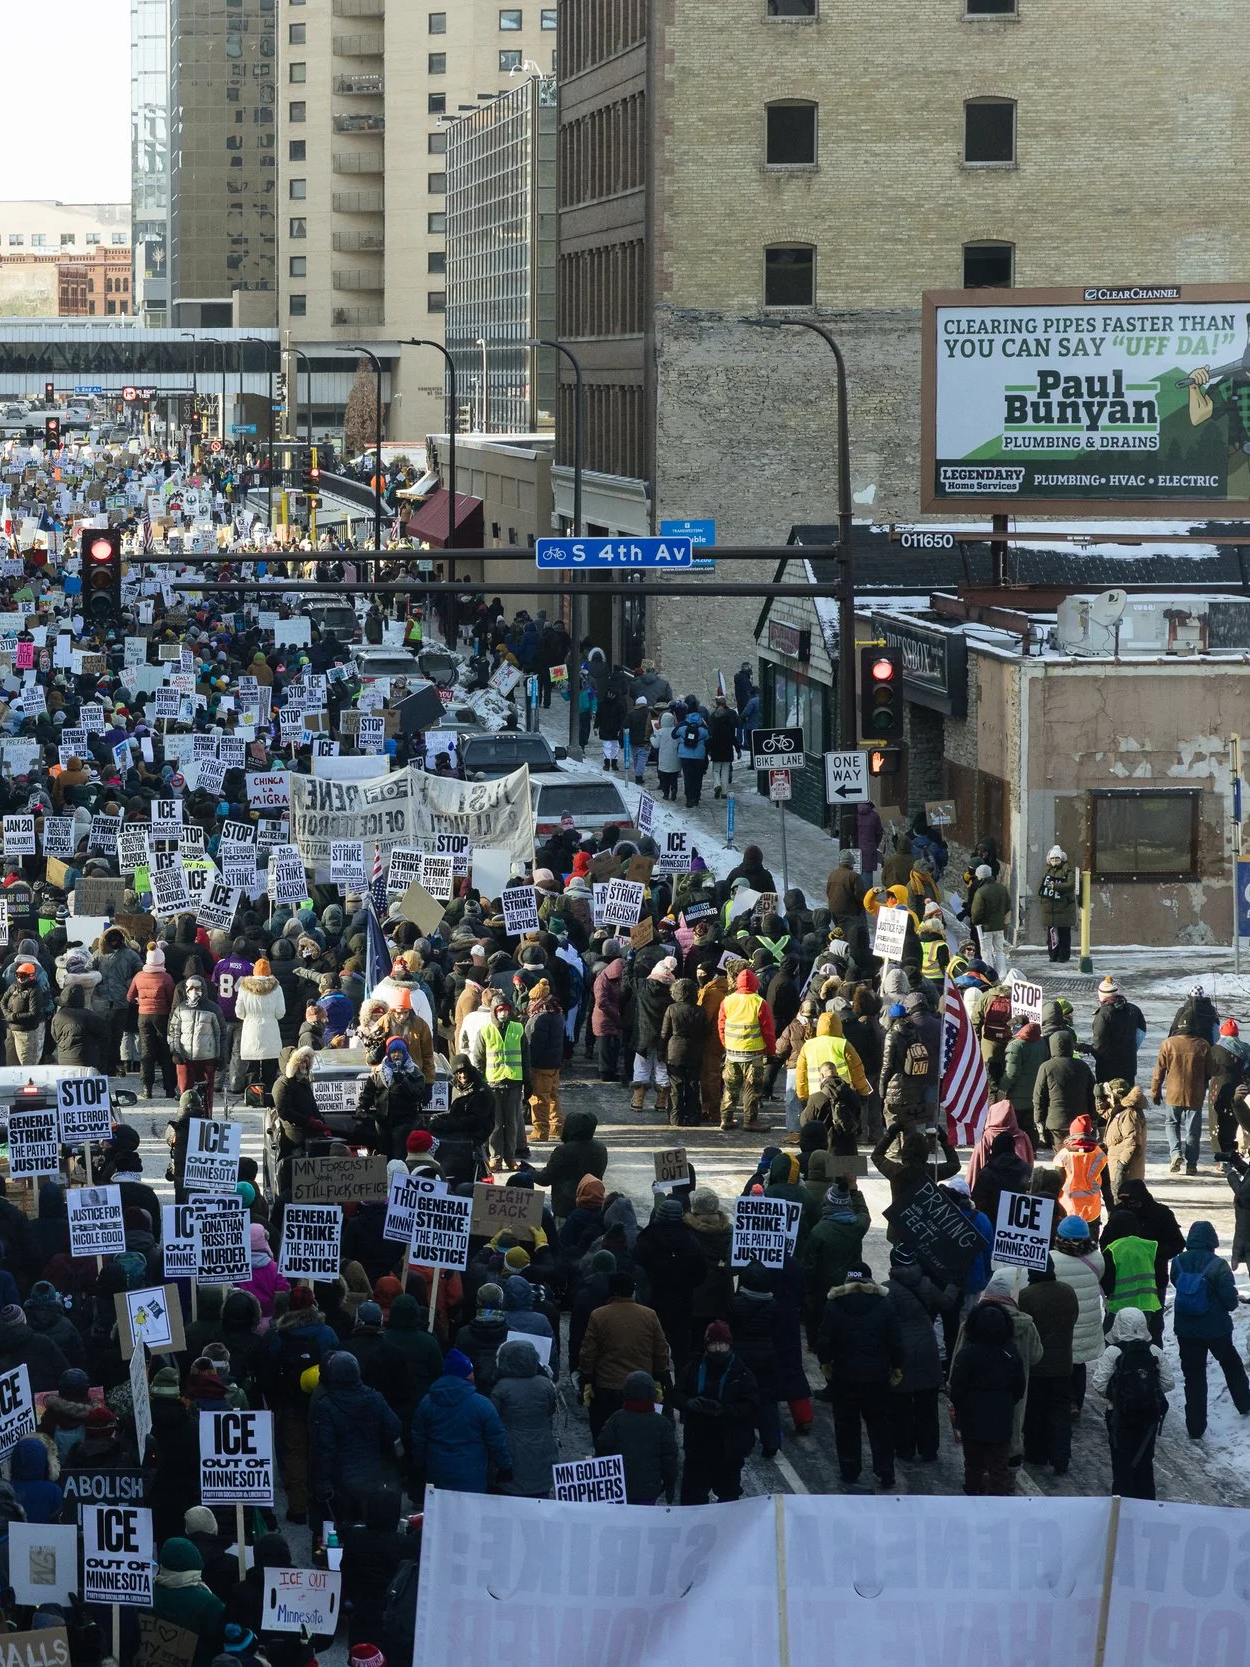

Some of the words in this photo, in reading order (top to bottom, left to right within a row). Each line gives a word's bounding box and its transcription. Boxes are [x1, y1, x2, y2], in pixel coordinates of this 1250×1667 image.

[944, 319, 1038, 334] CLEARING
[1042, 318, 1096, 334] PIPES
[1102, 316, 1173, 332] FASTER
[1179, 315, 1235, 331] THAN
[944, 339, 994, 358] YOU
[1002, 338, 1051, 357] CAN
[1058, 338, 1106, 356] SAY
[1037, 369, 1124, 399] Paul
[1005, 395, 1158, 431] Bunyan
[1004, 437, 1081, 448] PLUMBING
[1086, 437, 1096, 448] &
[1100, 437, 1158, 448] DRAINS
[942, 469, 1023, 481] LEGENDARY
[1034, 474, 1100, 486] PLUMBING
[1109, 475, 1145, 486] HVAC
[1158, 475, 1218, 487] ELECTRIC
[948, 482, 975, 490] Home
[977, 482, 1018, 490] Services
[901, 534, 953, 548] 011650
[572, 545, 586, 561] S
[599, 544, 642, 561] 4th
[656, 544, 685, 560] Av
[1, 640, 17, 650] STOP
[19, 644, 31, 654] ICE
[18, 654, 31, 663] OUT
[756, 756, 774, 767] BIKE
[781, 755, 803, 765] LANE
[833, 756, 860, 768] ONE
[833, 769, 861, 781] WAY
[253, 795, 288, 804] MIGRA
[4, 820, 19, 832] JAN
[21, 819, 32, 832] 20
[667, 833, 686, 851] ICE
[660, 859, 690, 868] MINNESOTA
[62, 1079, 107, 1106] STOP
[63, 1111, 75, 1124] ICE
[77, 1111, 108, 1124] TERROR
[64, 1123, 109, 1132] NOW!
[737, 1201, 785, 1217] GENERAL
[1008, 1195, 1042, 1231] ICE
[736, 1215, 785, 1231] STRIKE:
[736, 1232, 750, 1245] THE
[752, 1233, 772, 1246] PATH
[773, 1235, 783, 1247] TO
[997, 1230, 1027, 1241] OUT
[1030, 1236, 1048, 1245] OF
[734, 1247, 782, 1262] JUSTICE
[995, 1240, 1046, 1261] MINNESOTA
[213, 1413, 257, 1455] ICE
[202, 1459, 242, 1468] OUT
[245, 1459, 271, 1468] OF
[202, 1470, 270, 1488] MINNESOTA
[555, 1465, 574, 1485] MN
[576, 1458, 621, 1481] GOLDEN
[63, 1475, 143, 1498] ABOLISH
[558, 1477, 624, 1502] GOPHERS
[279, 1572, 303, 1586] ICE
[308, 1573, 328, 1587] OUT
[278, 1604, 323, 1624] Minnesota
